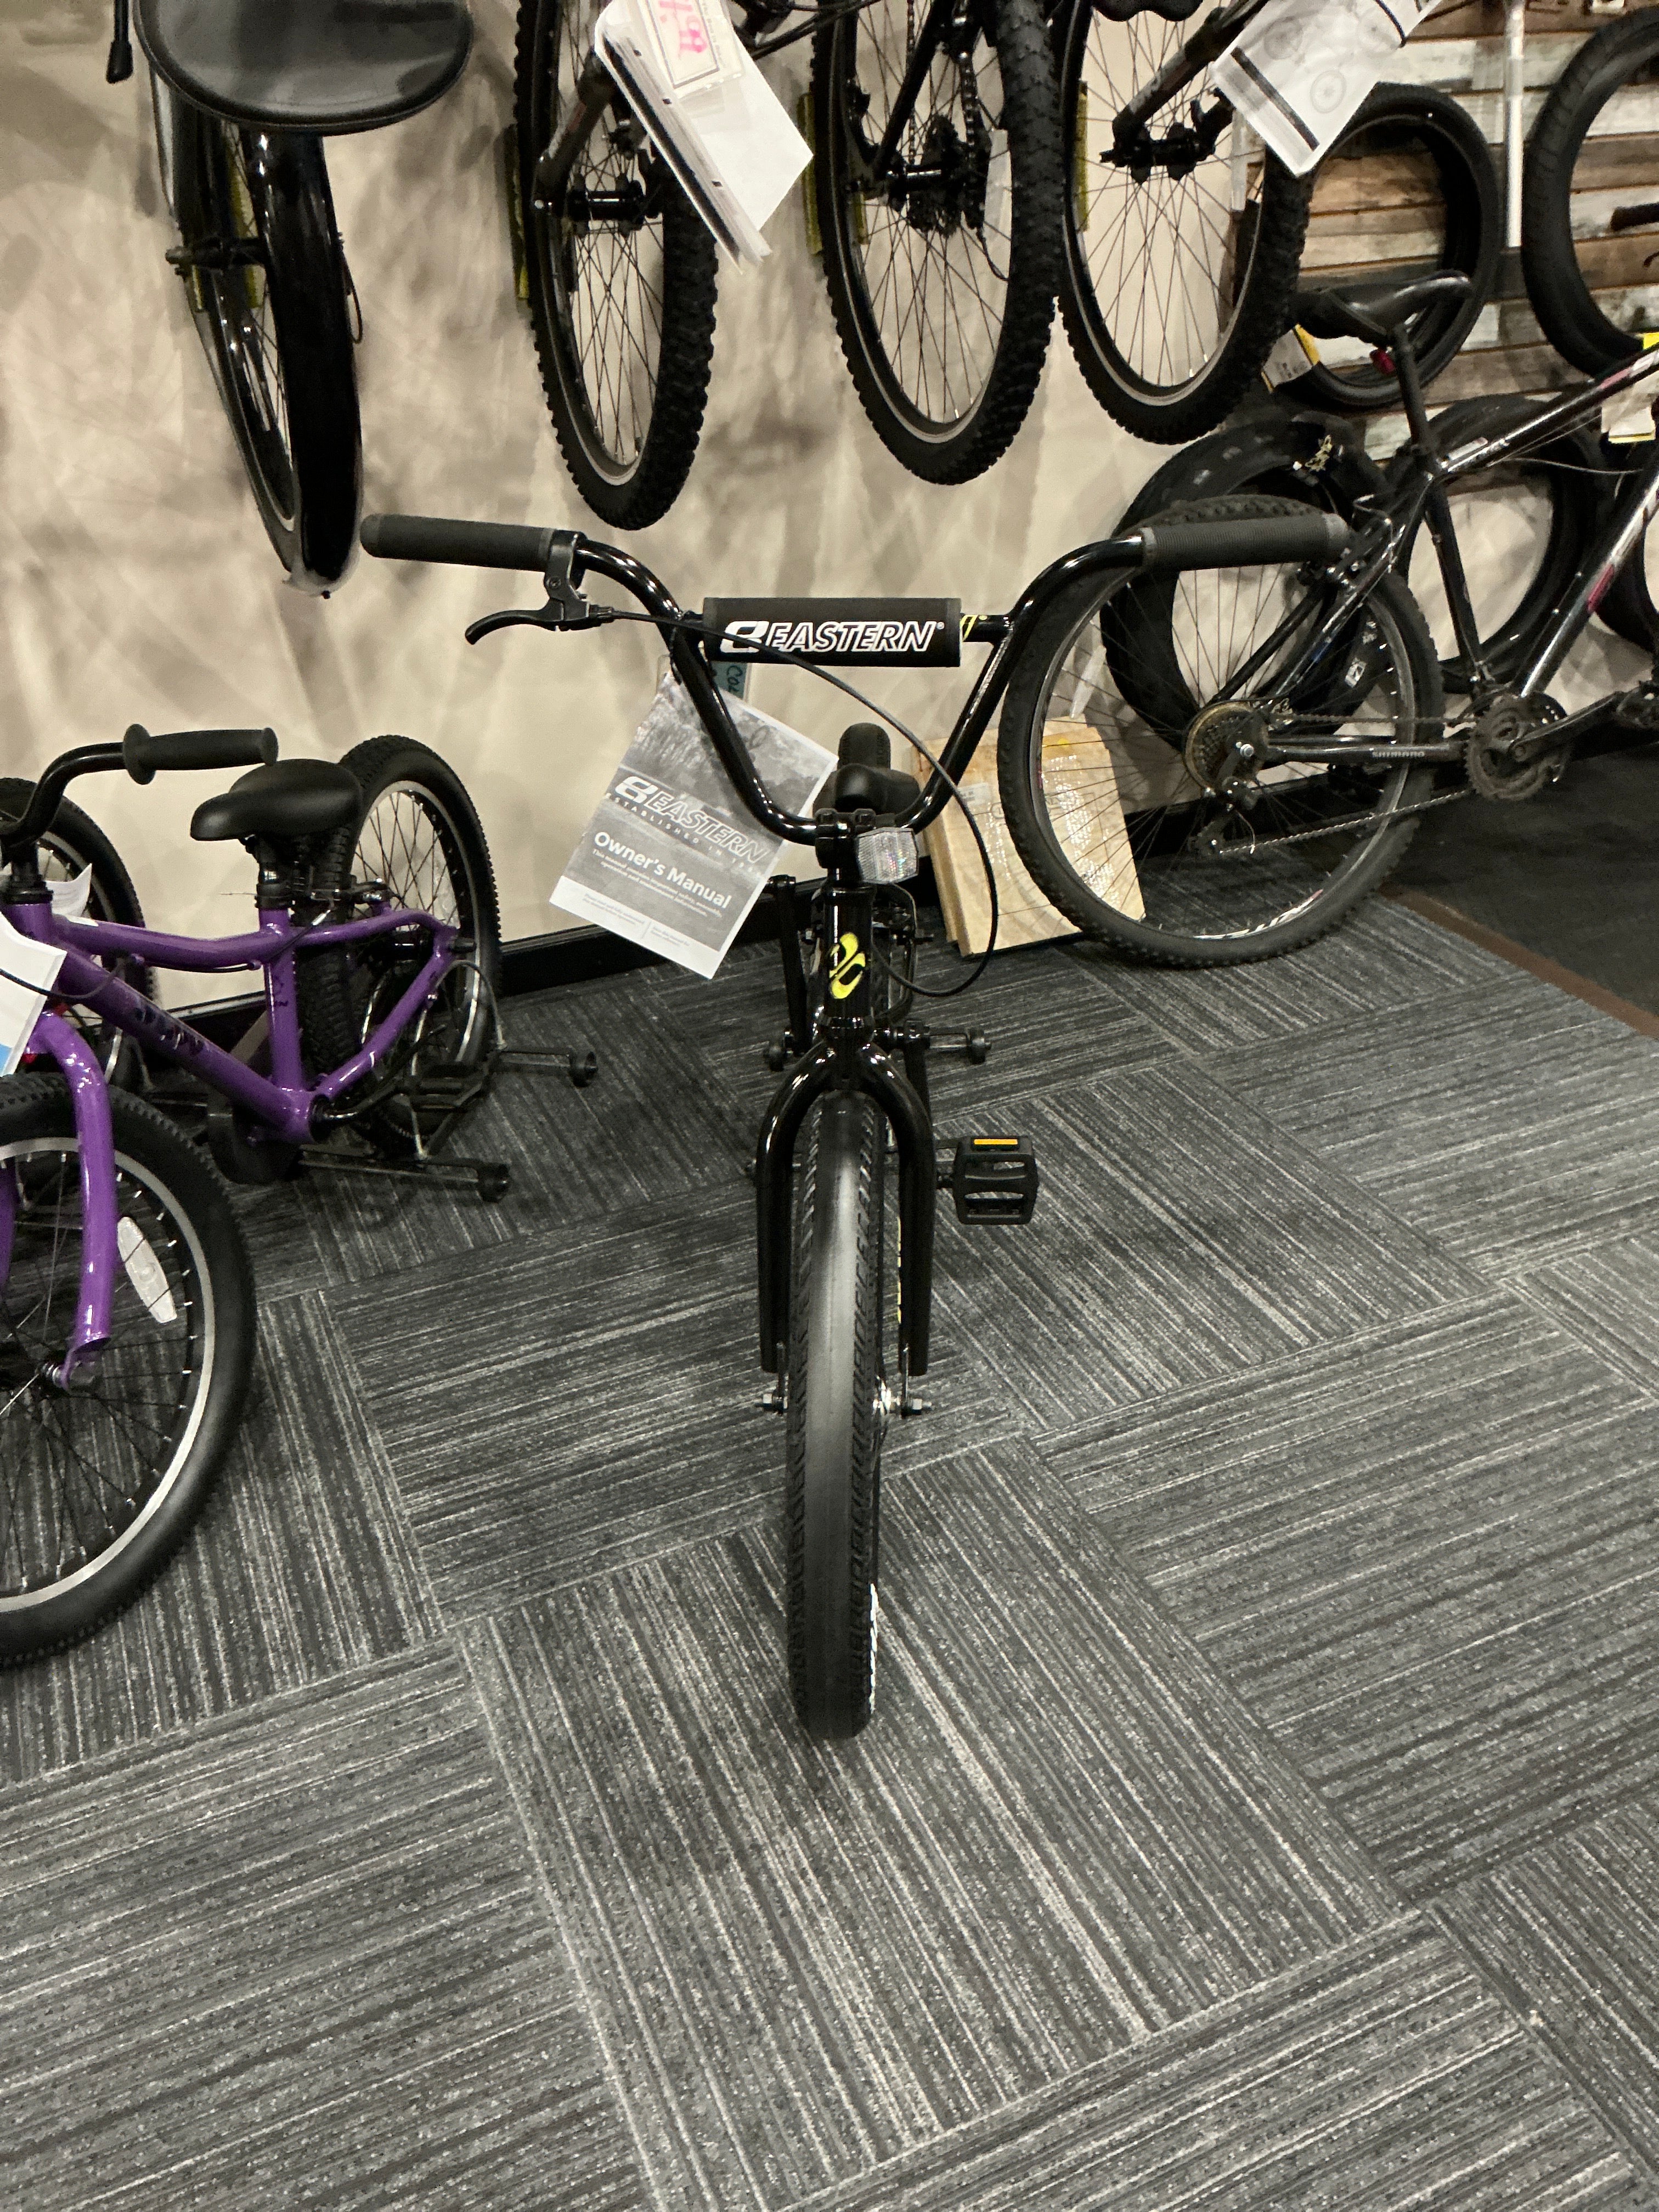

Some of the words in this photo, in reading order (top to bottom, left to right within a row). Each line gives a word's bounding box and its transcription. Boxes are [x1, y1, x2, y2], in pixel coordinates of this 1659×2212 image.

[606, 793, 699, 844] ESTABLISHED
[644, 791, 769, 864] EASTERN
[594, 831, 665, 876] Owner's
[667, 867, 732, 909] Manual
